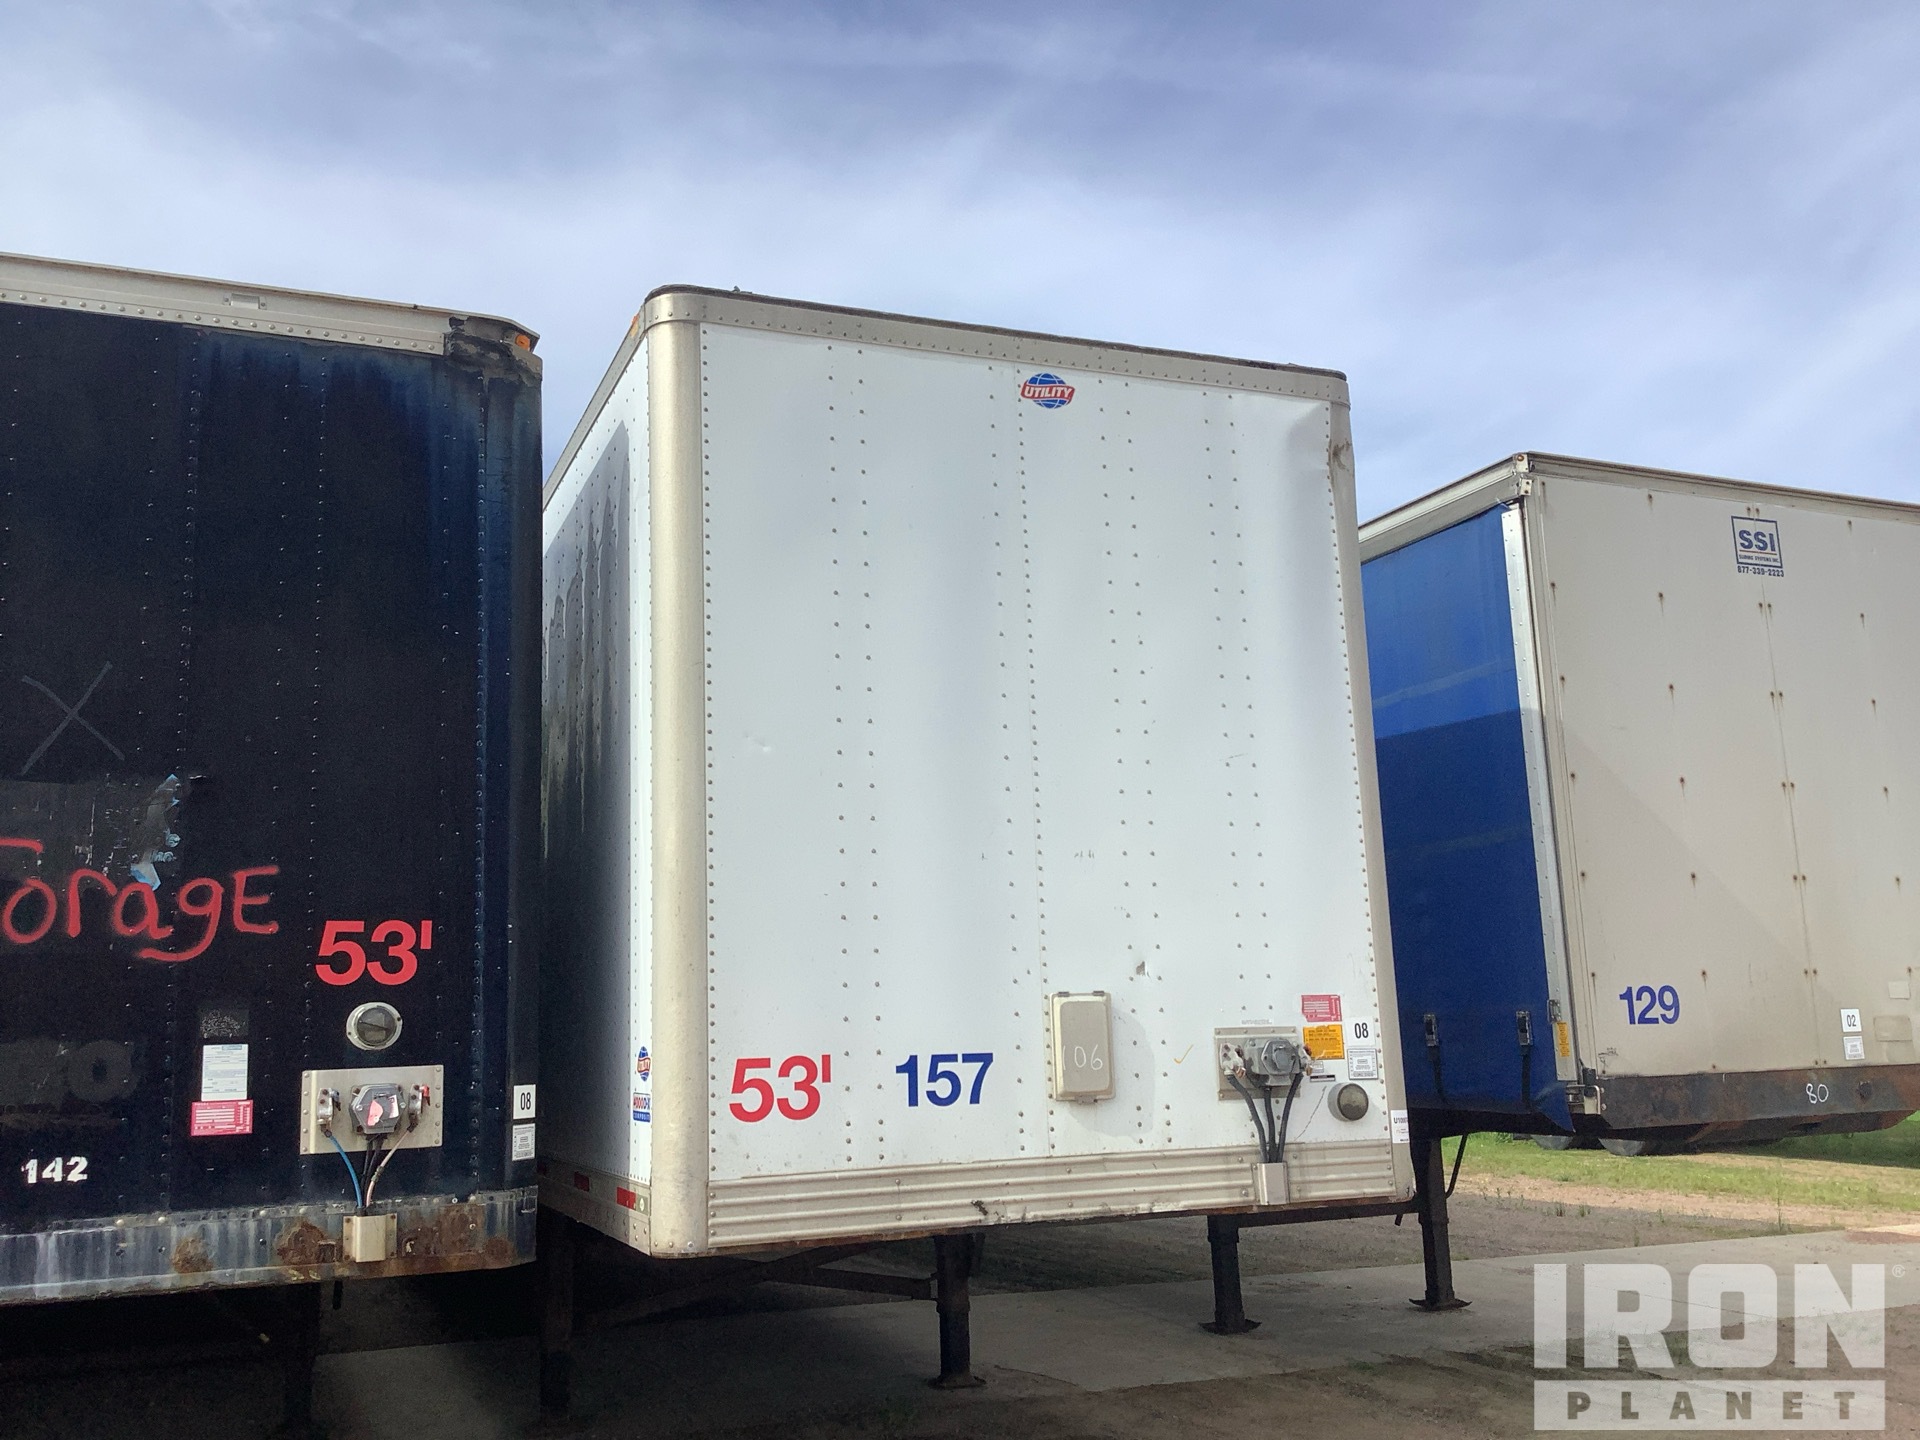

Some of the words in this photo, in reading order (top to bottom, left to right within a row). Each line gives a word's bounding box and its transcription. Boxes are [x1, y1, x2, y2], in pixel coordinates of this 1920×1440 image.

[1024, 385, 1072, 398] UTILITY
[1739, 530, 1776, 551] SSI
[1738, 566, 1784, 577] 877-339-2223
[315, 920, 433, 986] 53'
[1619, 985, 1680, 1025] 129
[1354, 1022, 1369, 1039] 08
[1846, 1014, 1857, 1028] 02
[729, 1054, 832, 1123] 53'
[895, 1052, 994, 1107] 157
[520, 1092, 532, 1111] 08
[1805, 1083, 1829, 1104] 80
[21, 1156, 88, 1184] 142
